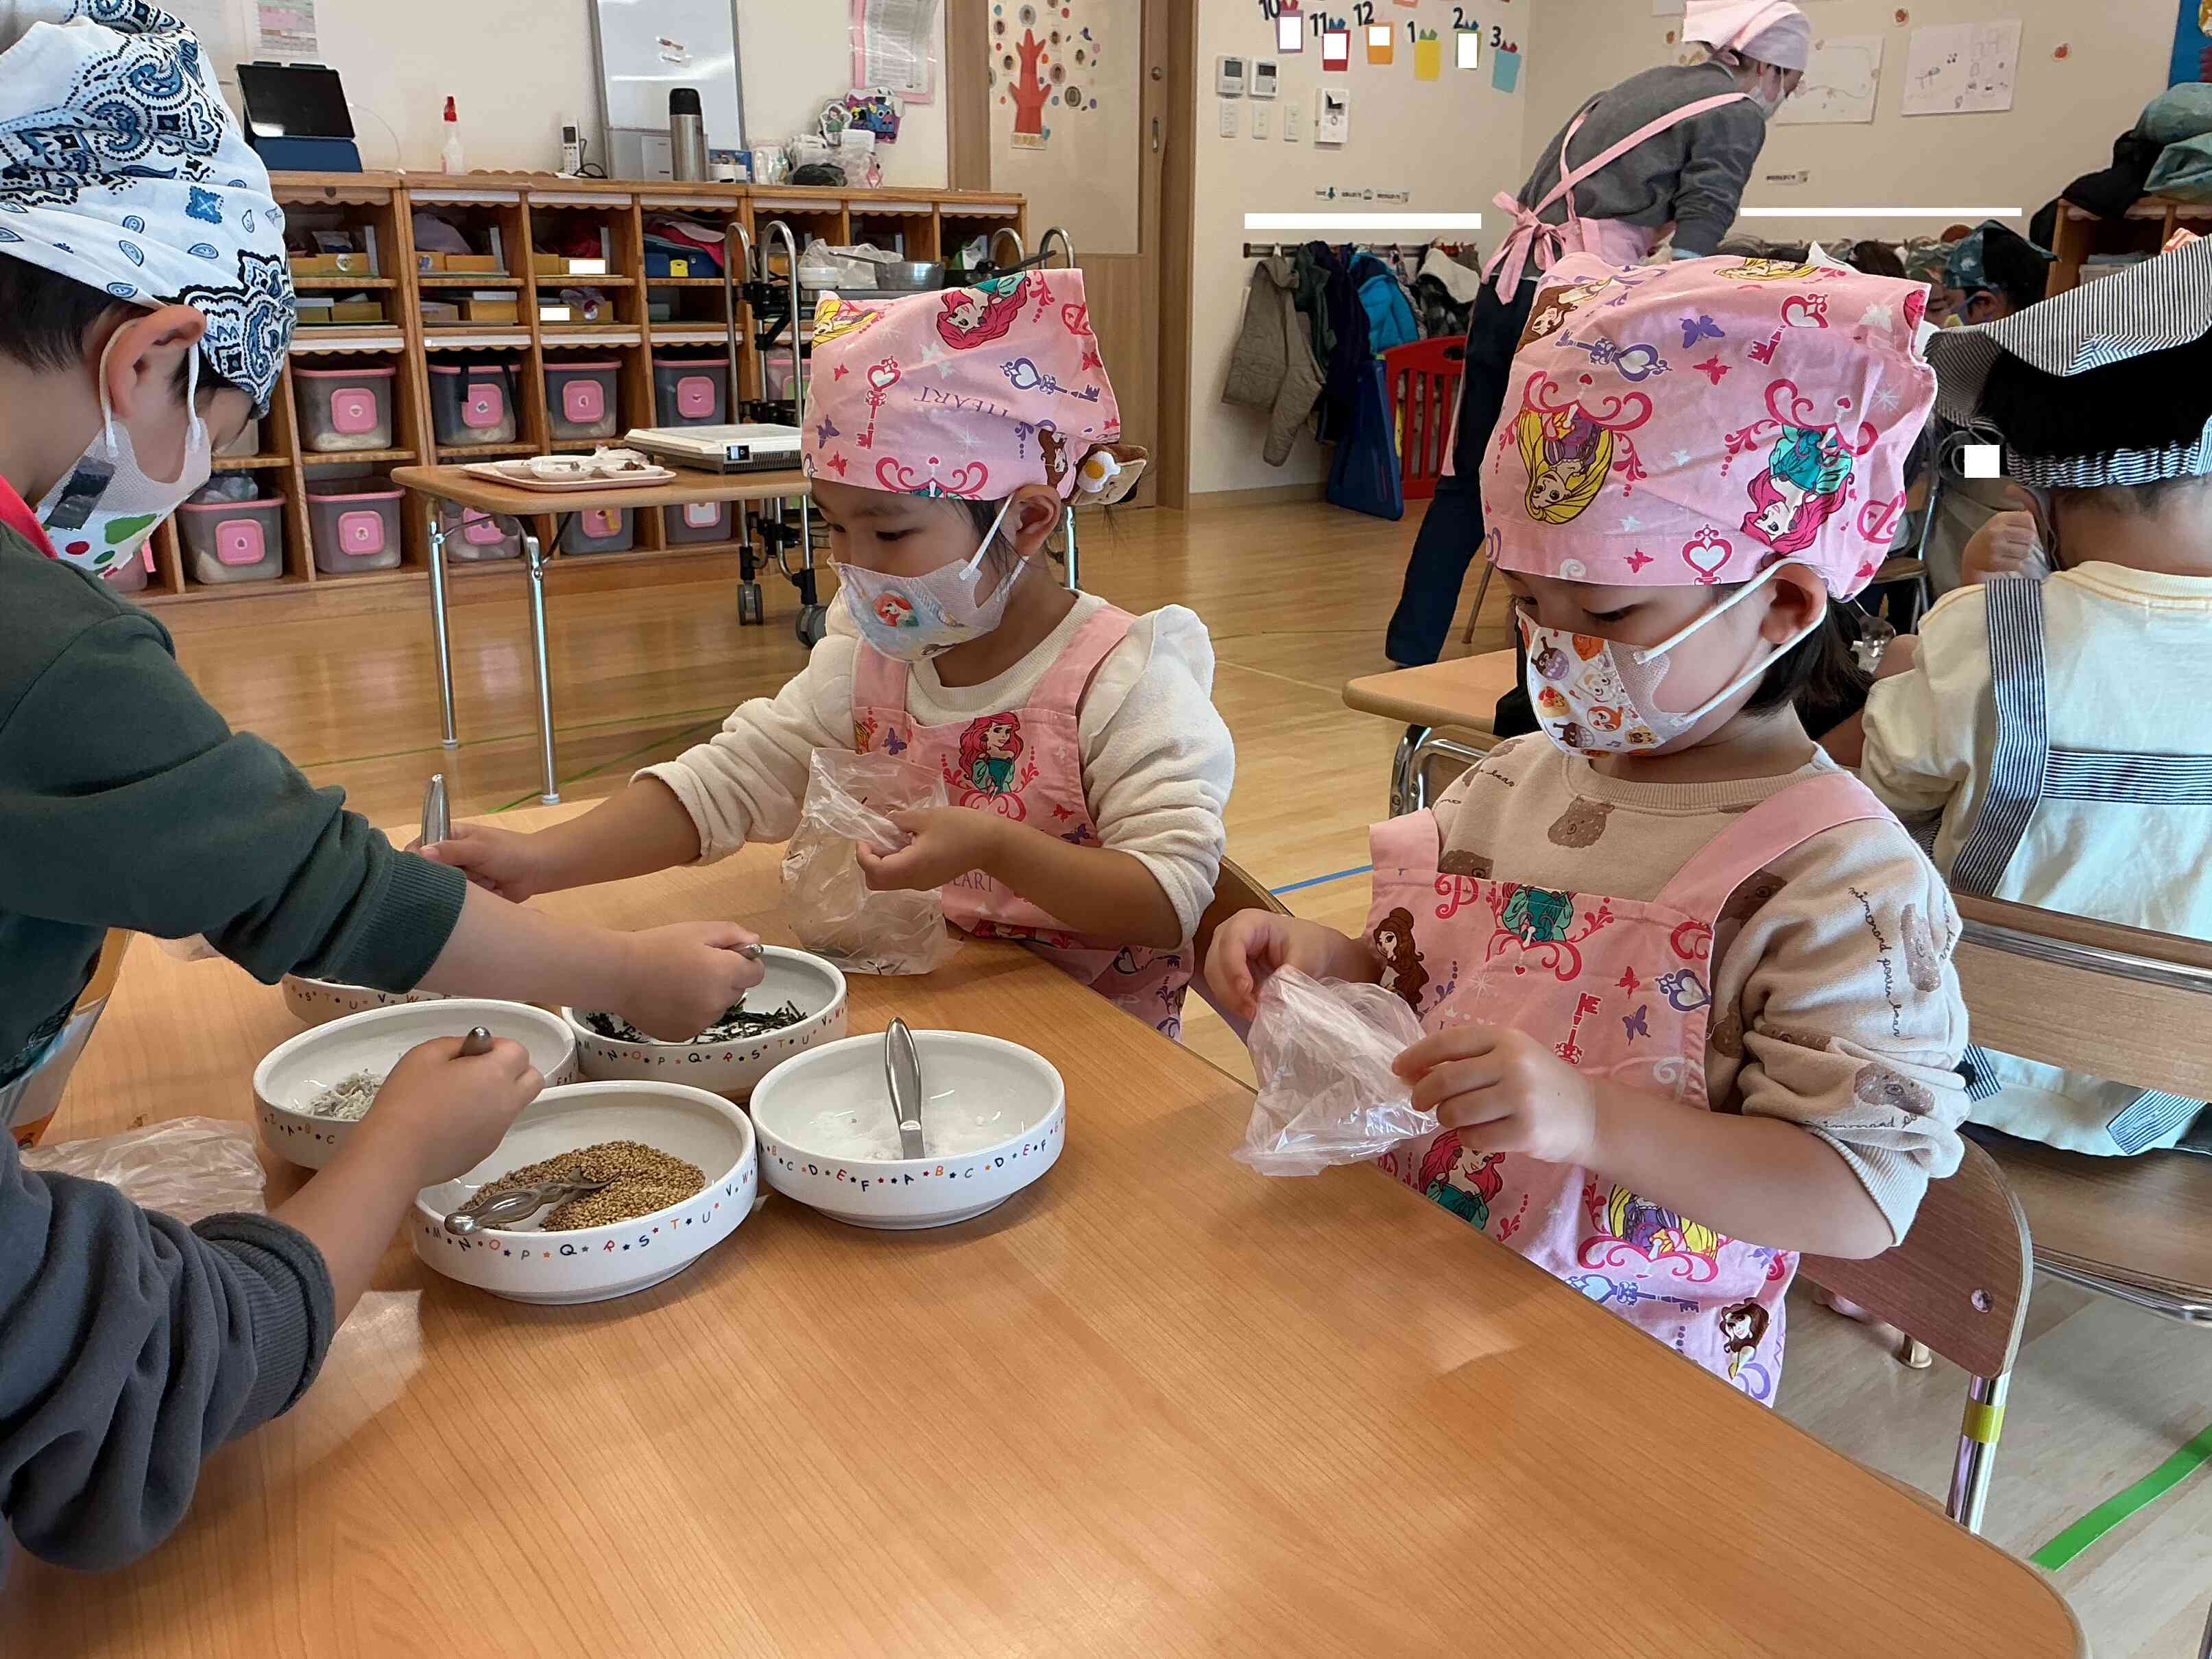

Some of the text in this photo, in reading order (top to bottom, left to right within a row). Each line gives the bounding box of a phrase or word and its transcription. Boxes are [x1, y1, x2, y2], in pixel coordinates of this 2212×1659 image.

[1259, 0, 1281, 21] 10
[1354, 1, 1375, 26] 12
[1452, 7, 1464, 29] 2
[1309, 12, 1327, 36] 11
[1407, 21, 1416, 43] 1
[1490, 25, 1502, 47] 3
